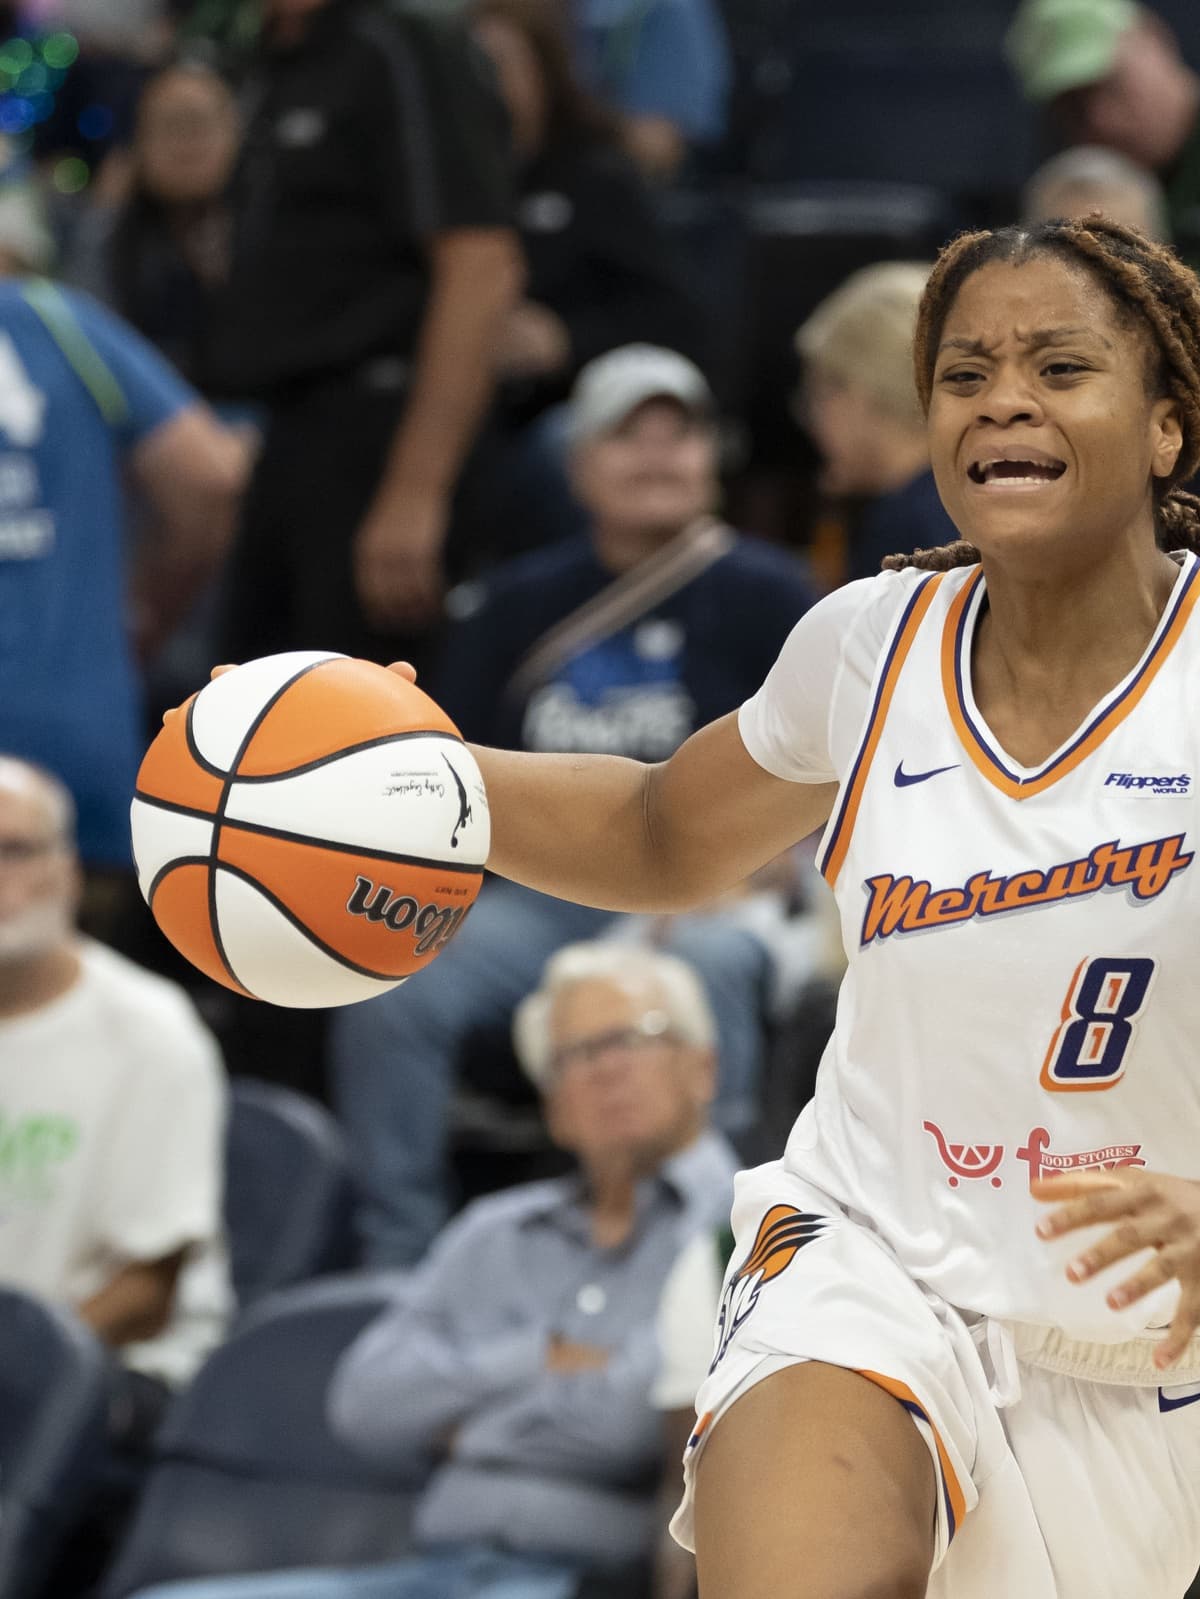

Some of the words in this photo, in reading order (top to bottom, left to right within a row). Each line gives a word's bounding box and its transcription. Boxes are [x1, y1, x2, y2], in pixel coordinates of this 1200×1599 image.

[1104, 773, 1191, 789] Flipper's
[346, 874, 468, 956] ilson
[860, 832, 1195, 949] Mercury
[1039, 954, 1157, 1093] 8
[1041, 1152, 1073, 1168] FOOD
[1078, 1147, 1134, 1165] STORES
